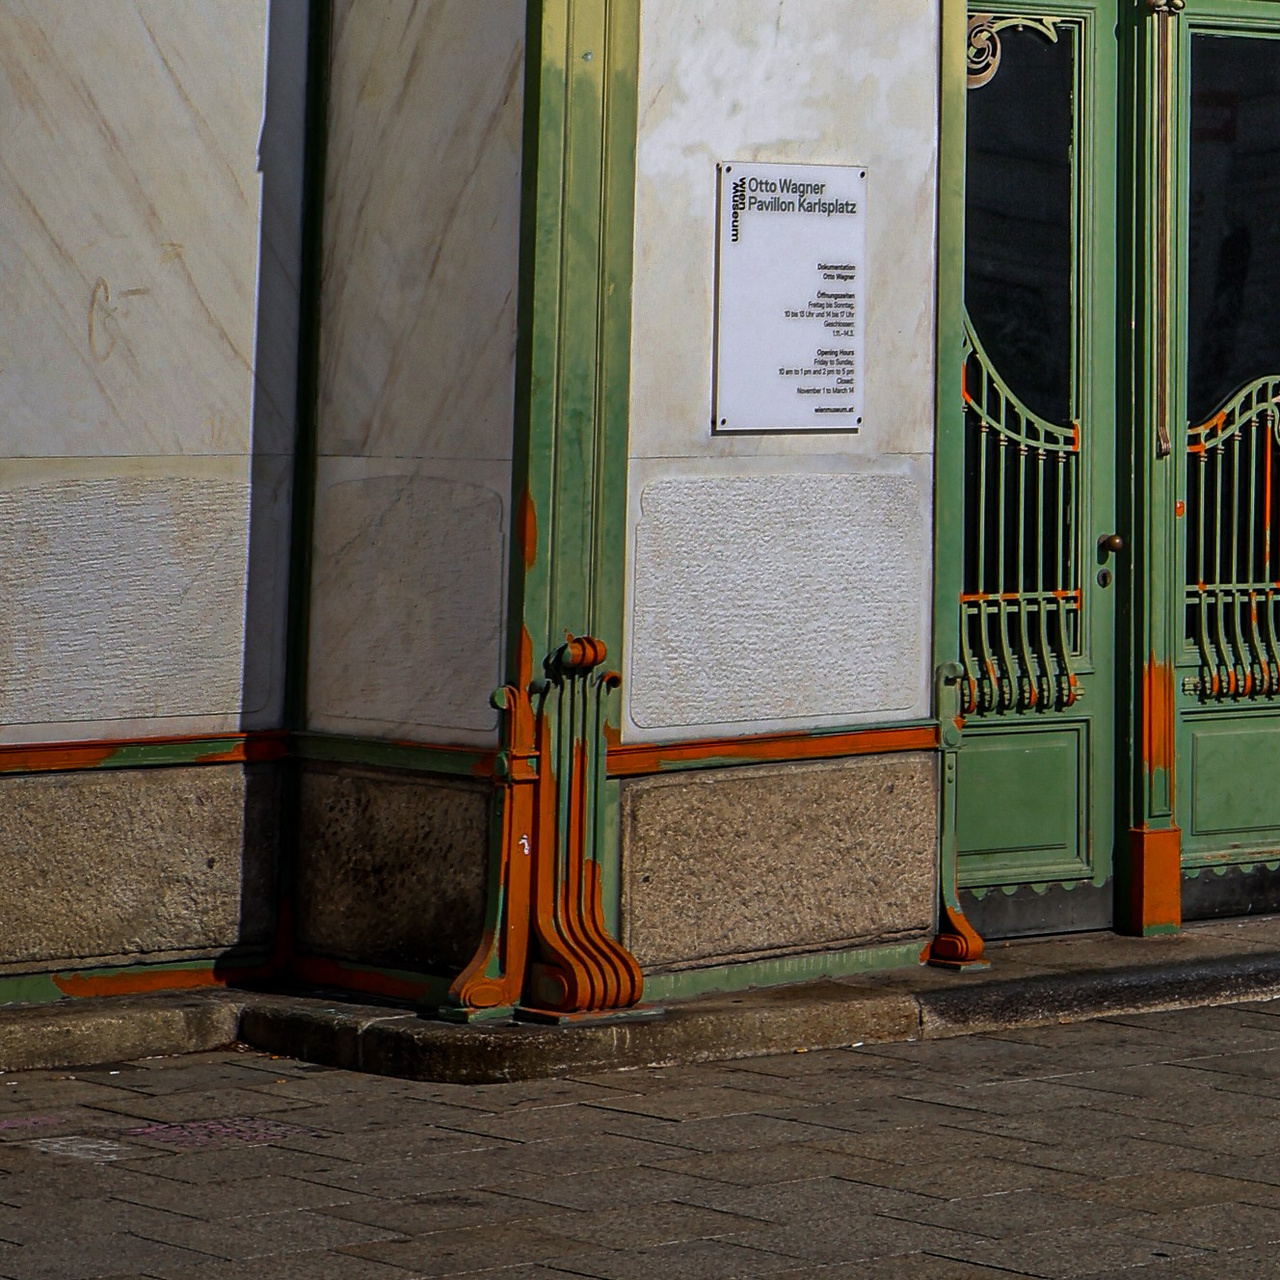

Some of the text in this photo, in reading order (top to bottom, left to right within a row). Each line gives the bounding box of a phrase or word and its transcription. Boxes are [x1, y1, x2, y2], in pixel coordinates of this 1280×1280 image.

[748, 177, 826, 197] Otto Wagner
[748, 195, 857, 217] Pavillon Karlsplatz
[836, 273, 855, 281] Wagner
[817, 290, 855, 300] Öffnungszeiten
[808, 301, 825, 309] Freitag
[817, 349, 838, 357] Opening
[814, 358, 828, 366] Friday
